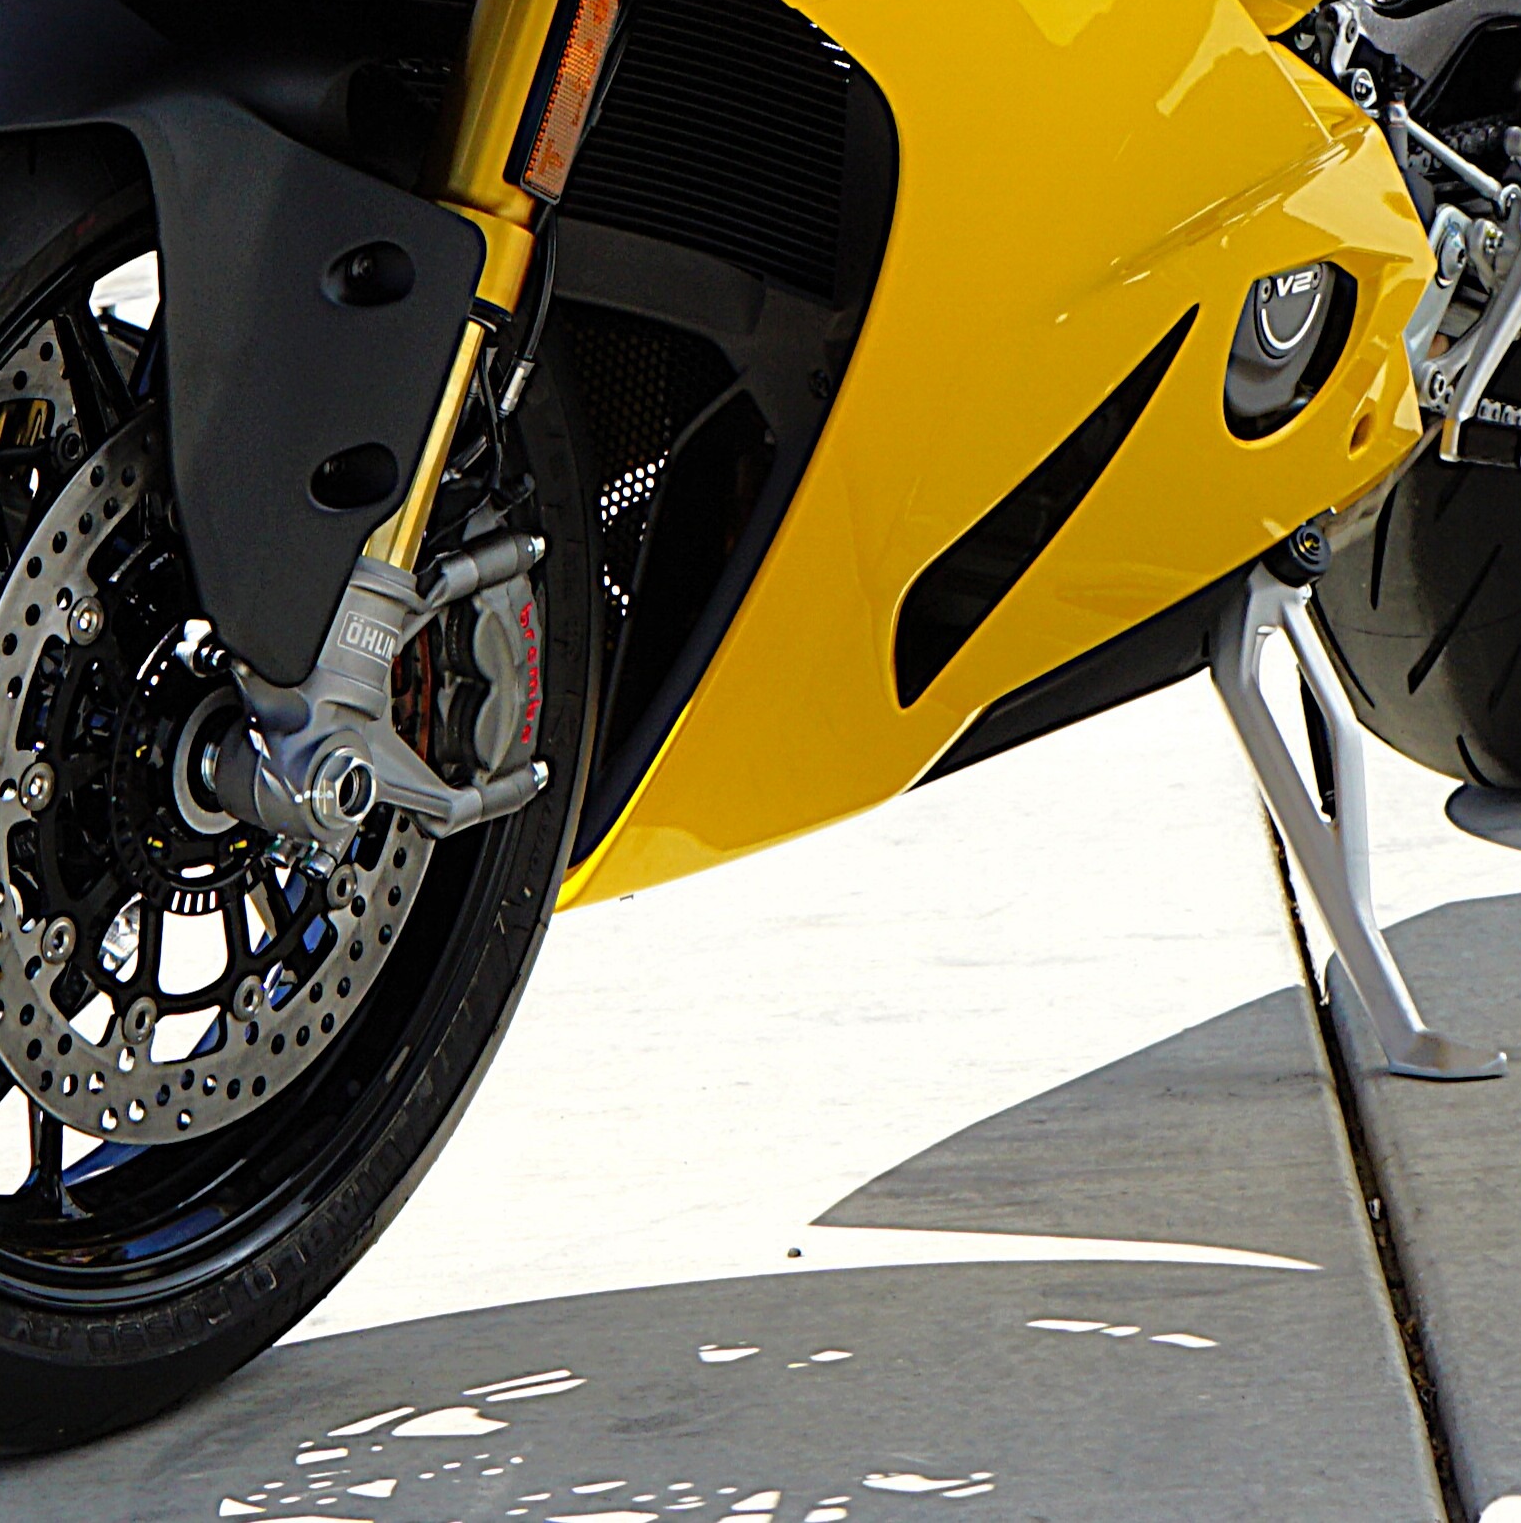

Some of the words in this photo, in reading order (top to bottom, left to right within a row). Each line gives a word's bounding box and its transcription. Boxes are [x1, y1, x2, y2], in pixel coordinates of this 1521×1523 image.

[1275, 270, 1315, 298] V2
[344, 616, 397, 661] ÖHLIN
[518, 601, 542, 745] brembo
